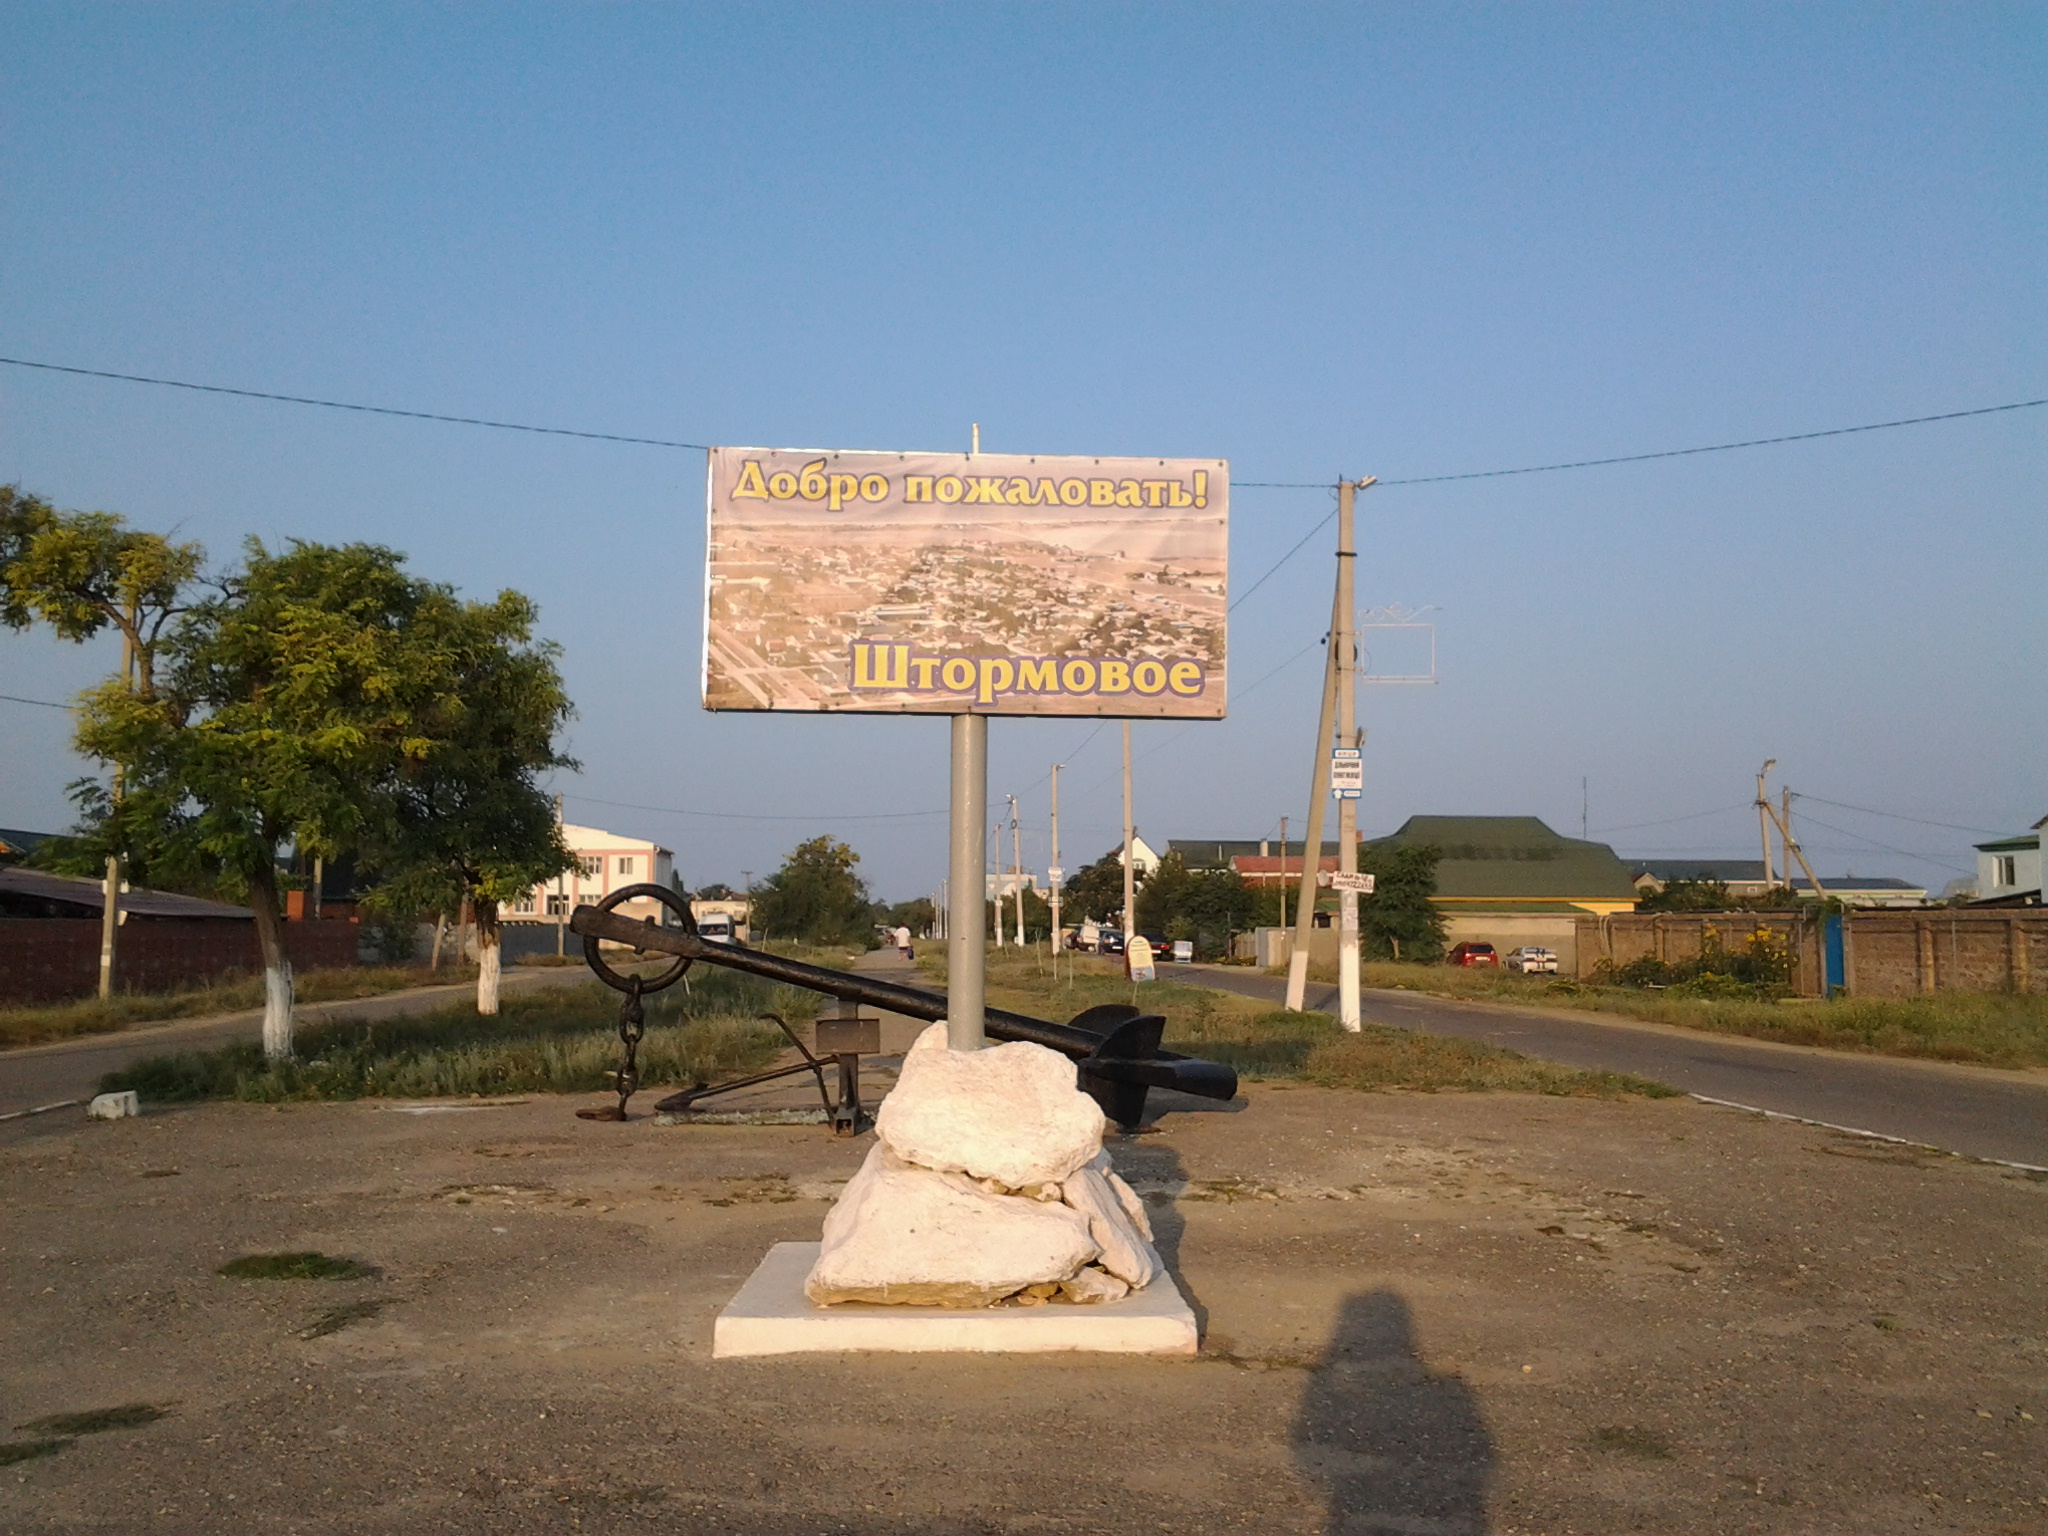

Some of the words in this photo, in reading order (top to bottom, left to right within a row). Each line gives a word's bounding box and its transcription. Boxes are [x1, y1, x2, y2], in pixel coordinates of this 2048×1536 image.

[732, 459, 889, 511] Добро
[905, 471, 1209, 508] пожаловать!
[851, 642, 1204, 705] Штормовое
